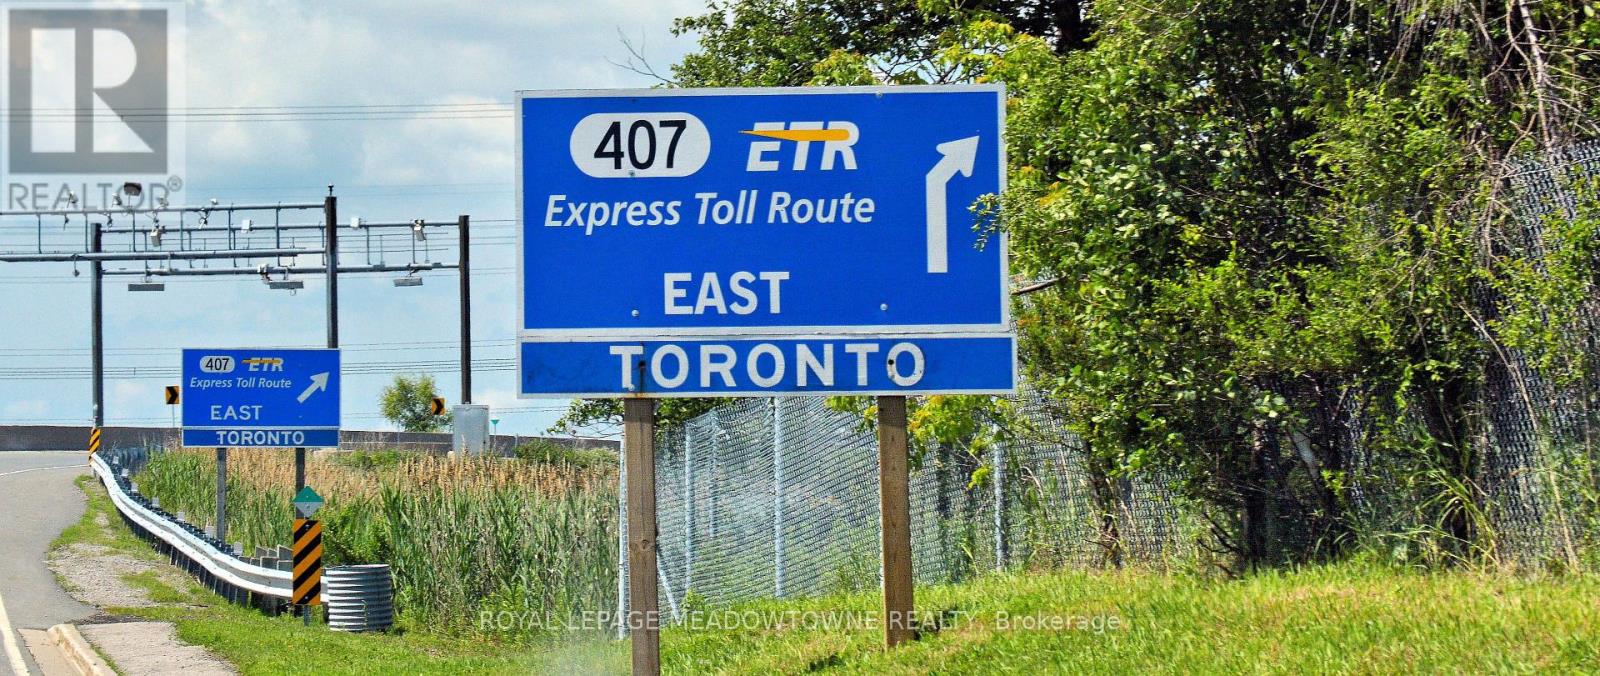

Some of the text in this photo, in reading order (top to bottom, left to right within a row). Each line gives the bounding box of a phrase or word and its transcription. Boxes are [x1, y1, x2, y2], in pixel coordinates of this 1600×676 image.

[593, 119, 687, 170] 407
[745, 121, 860, 172] ETR
[544, 189, 876, 236] Express Toll Route
[663, 271, 790, 316] EAST
[205, 358, 230, 371] 407
[247, 357, 284, 372] ETR
[609, 342, 926, 389] TORONTO
[189, 377, 292, 390] Express Toll Route
[210, 405, 263, 420] EAST
[216, 430, 305, 446] TORONTO
